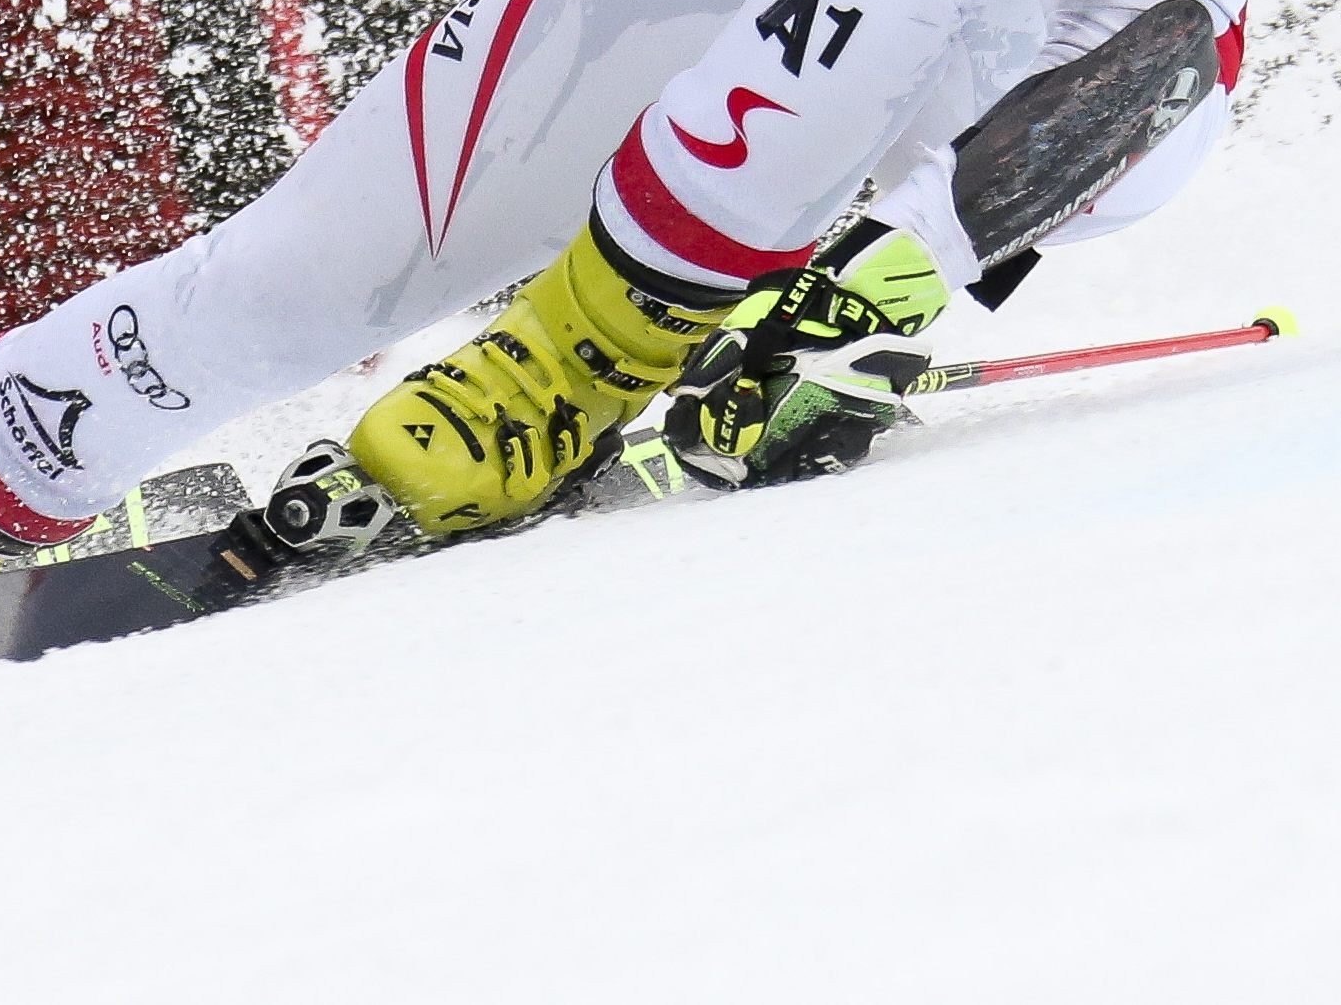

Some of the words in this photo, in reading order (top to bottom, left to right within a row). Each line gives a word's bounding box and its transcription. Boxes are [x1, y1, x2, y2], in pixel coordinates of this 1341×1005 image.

[781, 273, 817, 314] LEKI
[93, 322, 112, 375] Audi
[0, 377, 64, 480] Schöffel
[719, 400, 738, 452] LEKI
